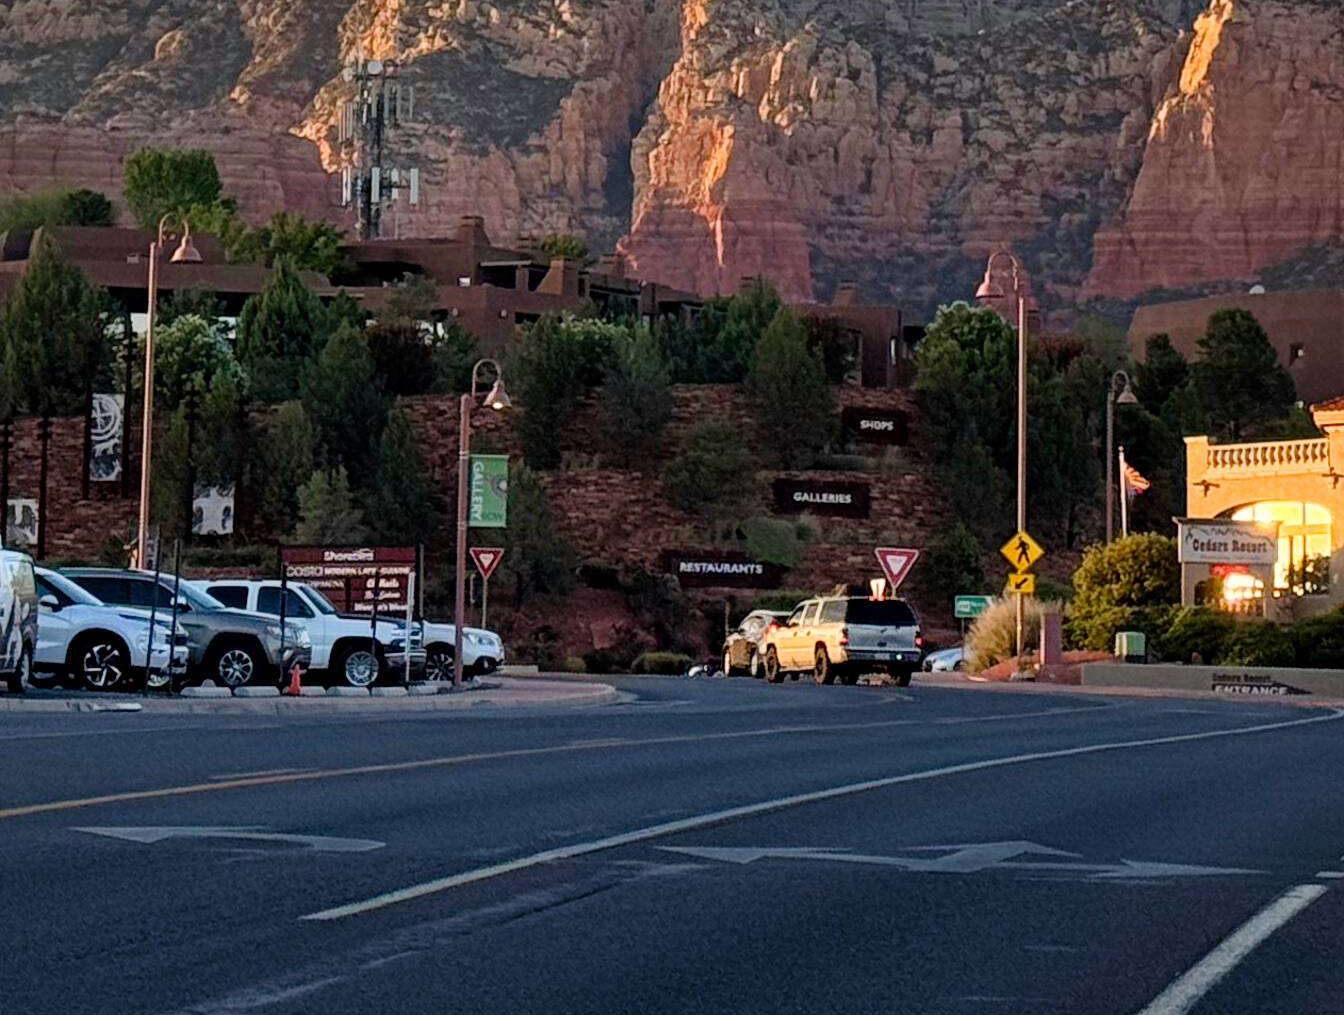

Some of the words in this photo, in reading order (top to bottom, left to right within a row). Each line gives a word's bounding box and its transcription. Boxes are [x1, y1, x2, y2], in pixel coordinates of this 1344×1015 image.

[859, 419, 894, 431] SHOPS
[471, 461, 485, 521] GALLERY
[793, 491, 852, 504] GALLERIES
[1192, 538, 1229, 552] Cedars
[1231, 539, 1268, 553] Resort
[679, 562, 763, 575] RESTAURANTS
[1215, 685, 1288, 696] ENTRANCE
